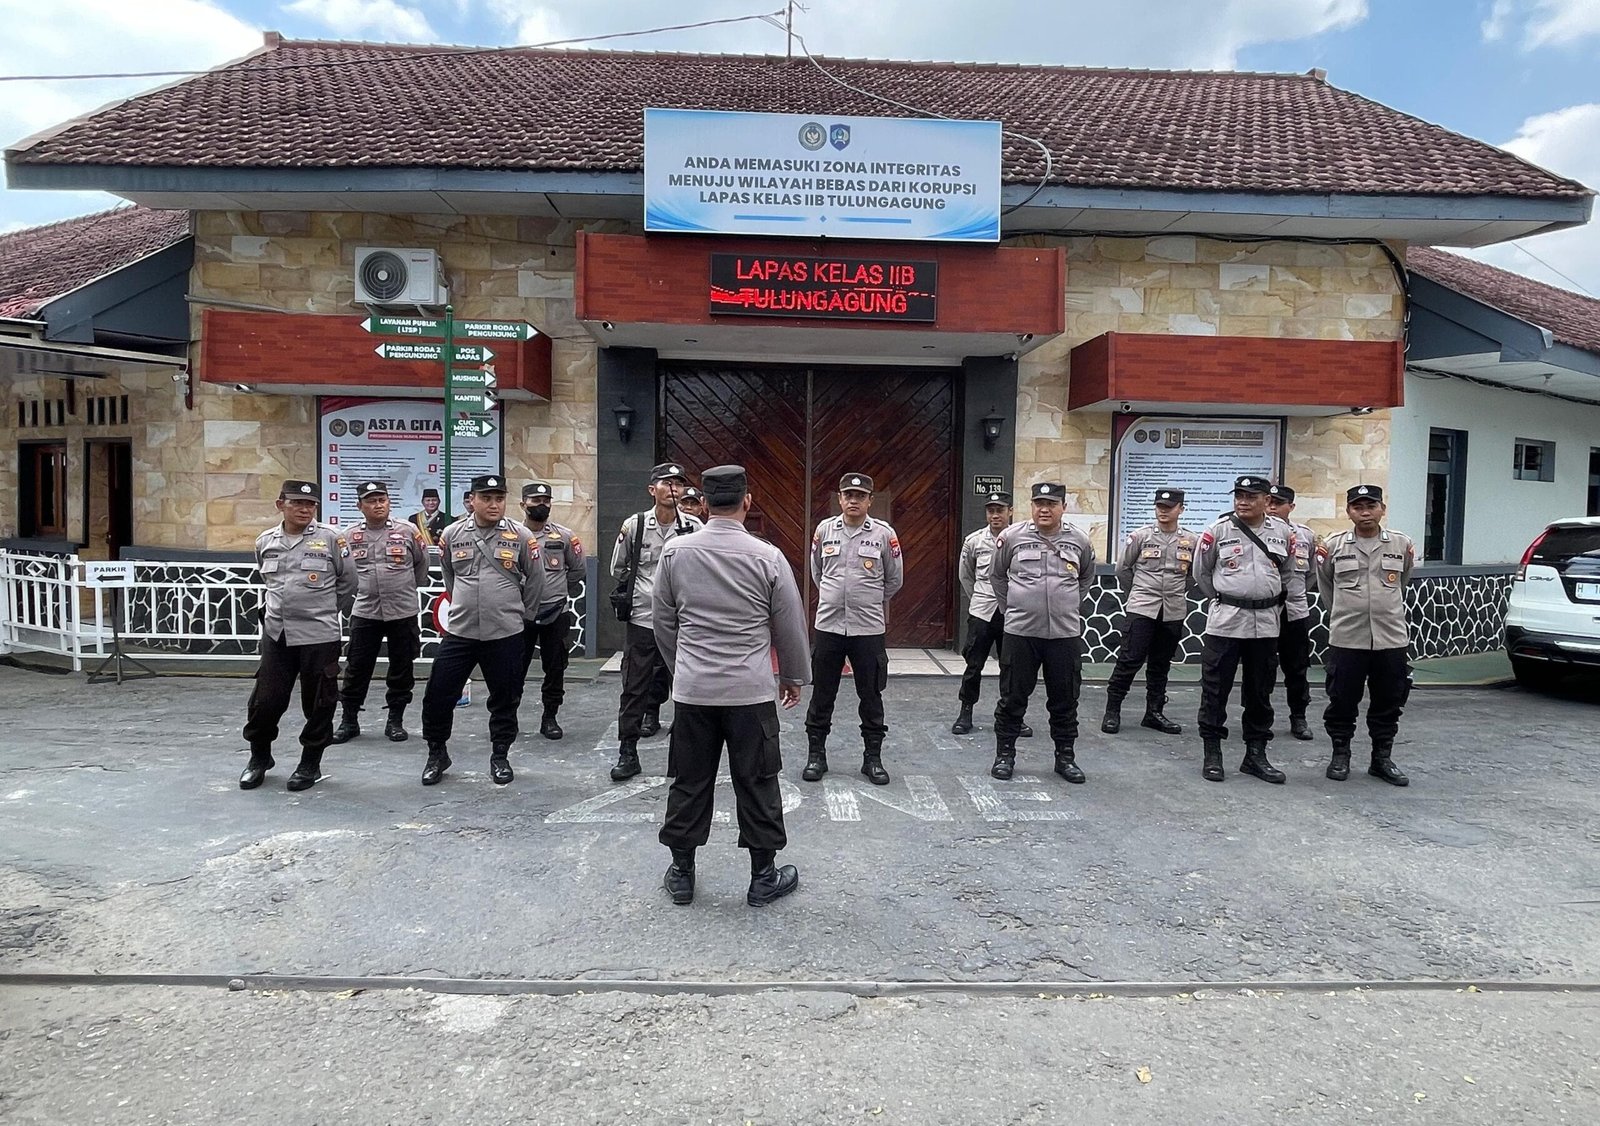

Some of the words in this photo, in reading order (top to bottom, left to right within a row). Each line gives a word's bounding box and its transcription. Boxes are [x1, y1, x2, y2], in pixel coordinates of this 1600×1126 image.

[684, 156, 731, 170] ANDA
[734, 157, 820, 172] MEMASUKI
[822, 160, 867, 174] ZONA
[870, 162, 961, 177] INTEGRITAS
[668, 174, 735, 188] MENUJU
[737, 176, 813, 190] WILAYAH
[815, 178, 866, 192] BEBAS
[868, 180, 906, 193] DARI
[909, 181, 977, 195] KORUPSI
[699, 190, 751, 204] LAPAS
[753, 192, 802, 206] KELAS
[804, 194, 825, 206] IIB
[827, 194, 946, 210] TULUNGAGUNG
[736, 259, 808, 282] LAPAS
[814, 262, 884, 285] KELAS
[889, 265, 916, 286] IIB
[741, 288, 908, 313] TULUNGAGUNG
[368, 418, 406, 430] ASTA
[410, 419, 443, 431] CITA
[1165, 428, 1181, 448] 13
[976, 484, 988, 493] No.
[990, 484, 1002, 493] 139
[498, 540, 520, 548] POLRI
[860, 540, 882, 548] POLRI
[1578, 584, 1584, 593] H
